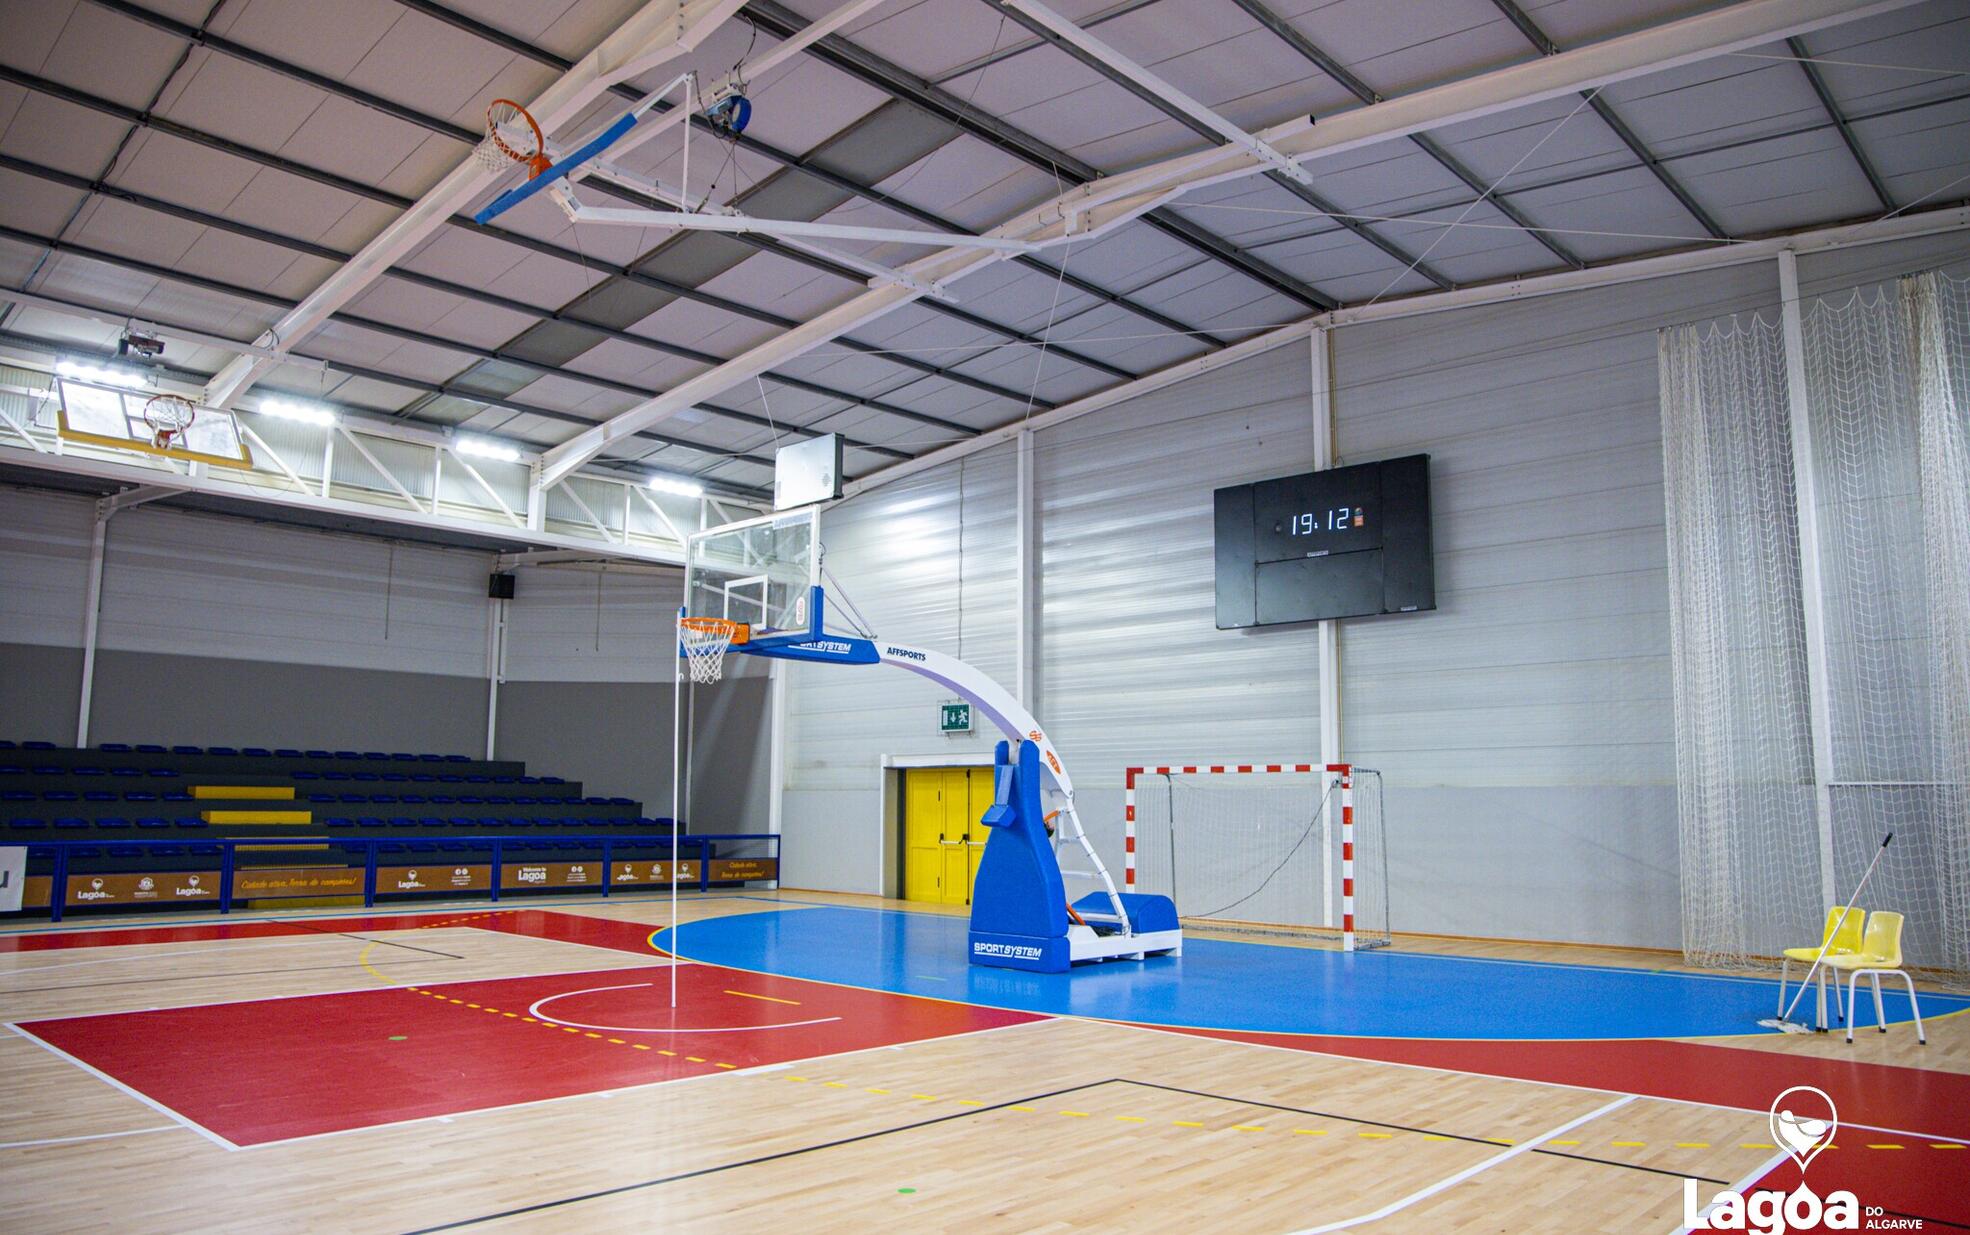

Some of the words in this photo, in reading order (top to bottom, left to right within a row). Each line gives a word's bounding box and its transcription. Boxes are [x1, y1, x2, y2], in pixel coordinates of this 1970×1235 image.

[1292, 508, 1350, 536] 19:12
[887, 647, 926, 661] AFFSPORTS
[518, 870, 546, 882] Lagoa
[77, 890, 106, 900] Lagoa
[176, 887, 202, 896] Lagoa
[974, 942, 1042, 959] SPORTSYSTEM
